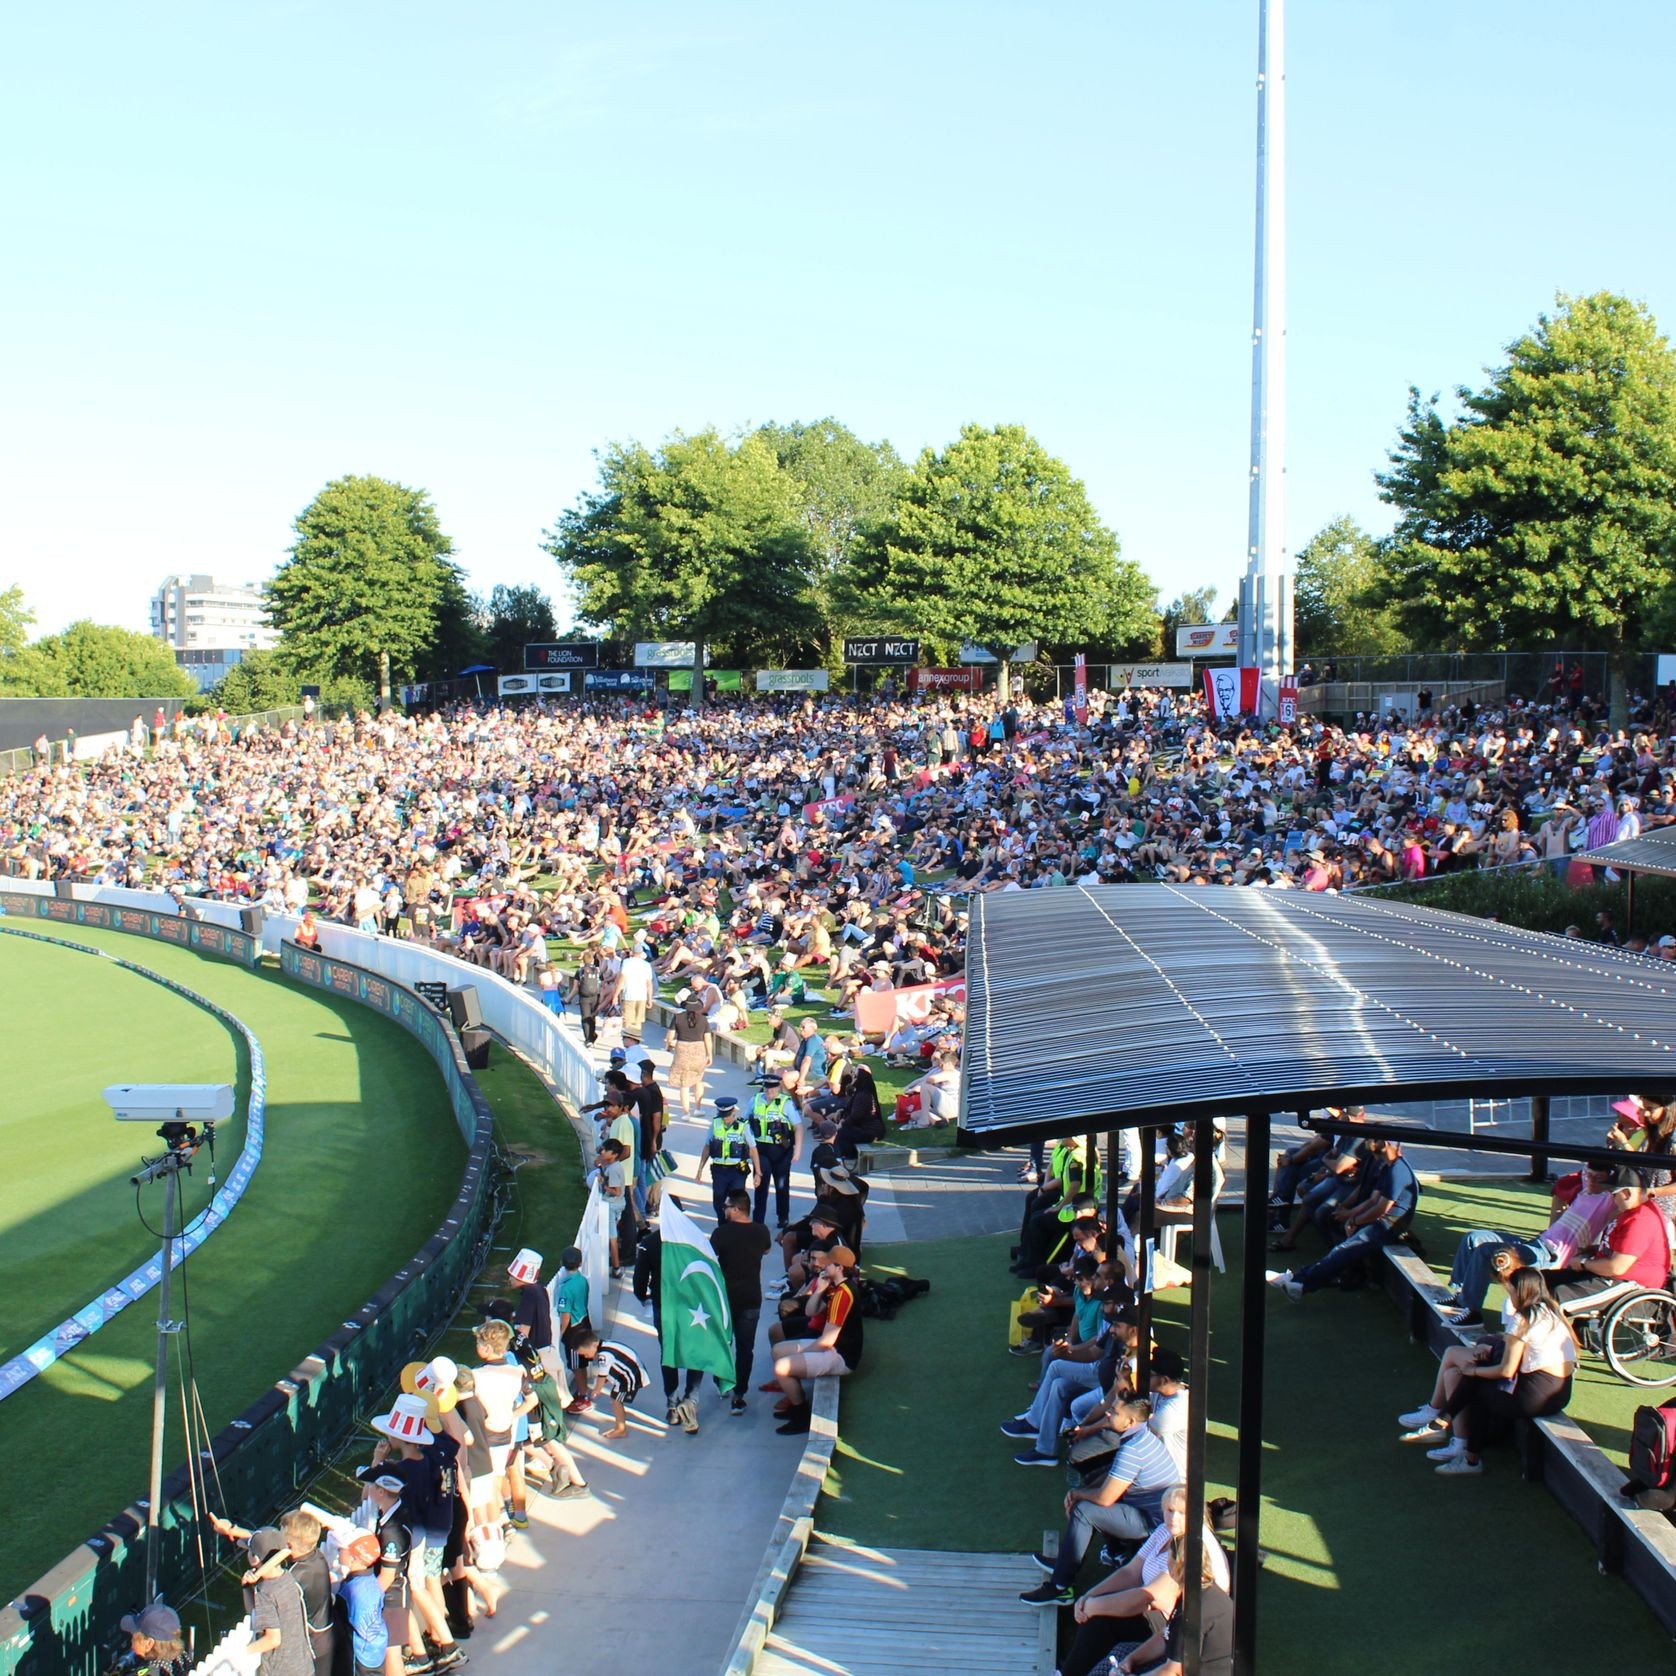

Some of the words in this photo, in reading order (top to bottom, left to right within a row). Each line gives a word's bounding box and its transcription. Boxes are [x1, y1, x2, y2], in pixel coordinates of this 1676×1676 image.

[848, 643, 878, 657] NZCT
[885, 642, 915, 656] NZCT
[768, 673, 814, 686] grassroots
[1285, 704, 1291, 716] 6
